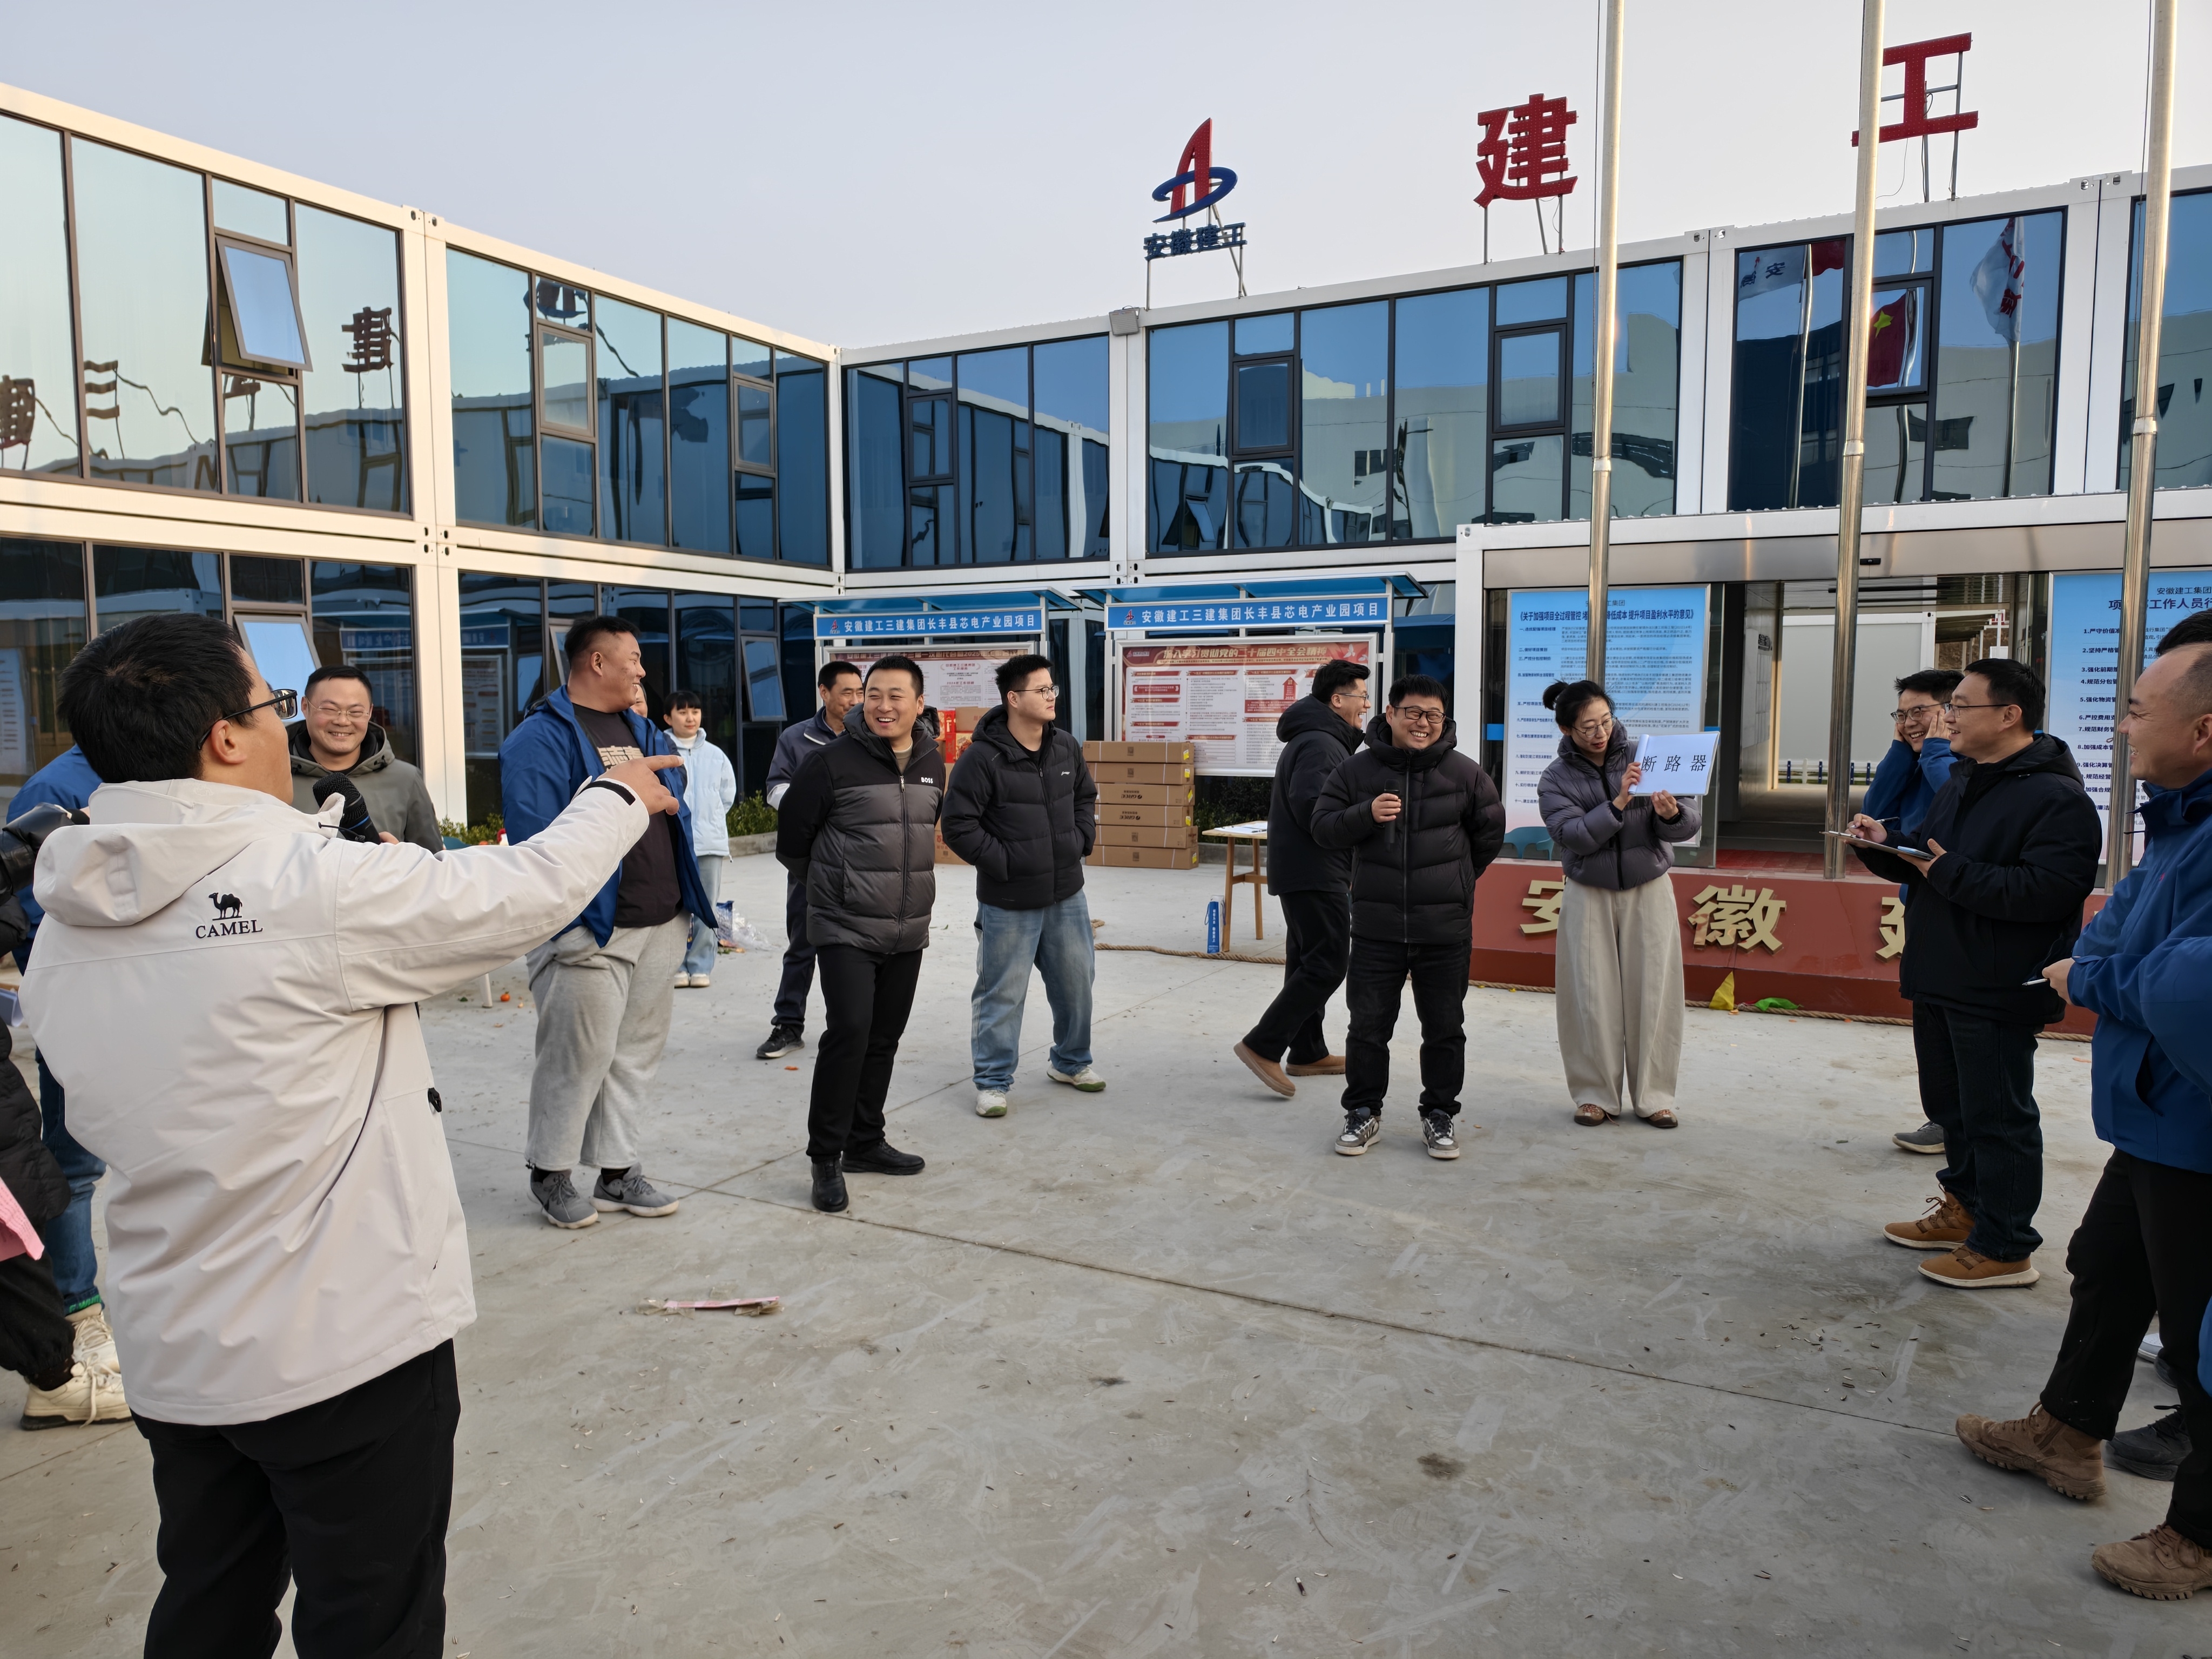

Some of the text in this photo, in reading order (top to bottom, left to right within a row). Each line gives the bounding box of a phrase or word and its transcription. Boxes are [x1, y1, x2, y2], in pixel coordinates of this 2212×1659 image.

[1473, 32, 1979, 208] 建 工
[1143, 222, 1248, 261] 安徽建工
[2157, 586, 2211, 595] 安徽建工集团
[1142, 602, 1378, 623] 安徽建工三建集团长丰县芯电产业园项目
[845, 614, 1035, 633] 安徽建工三建集团长丰县芯电产业园项目
[1163, 646, 1327, 659] 深入学习贯彻党的二十届四中全会精神
[1641, 754, 1707, 773] 断路器
[195, 919, 263, 939] CAMEL
